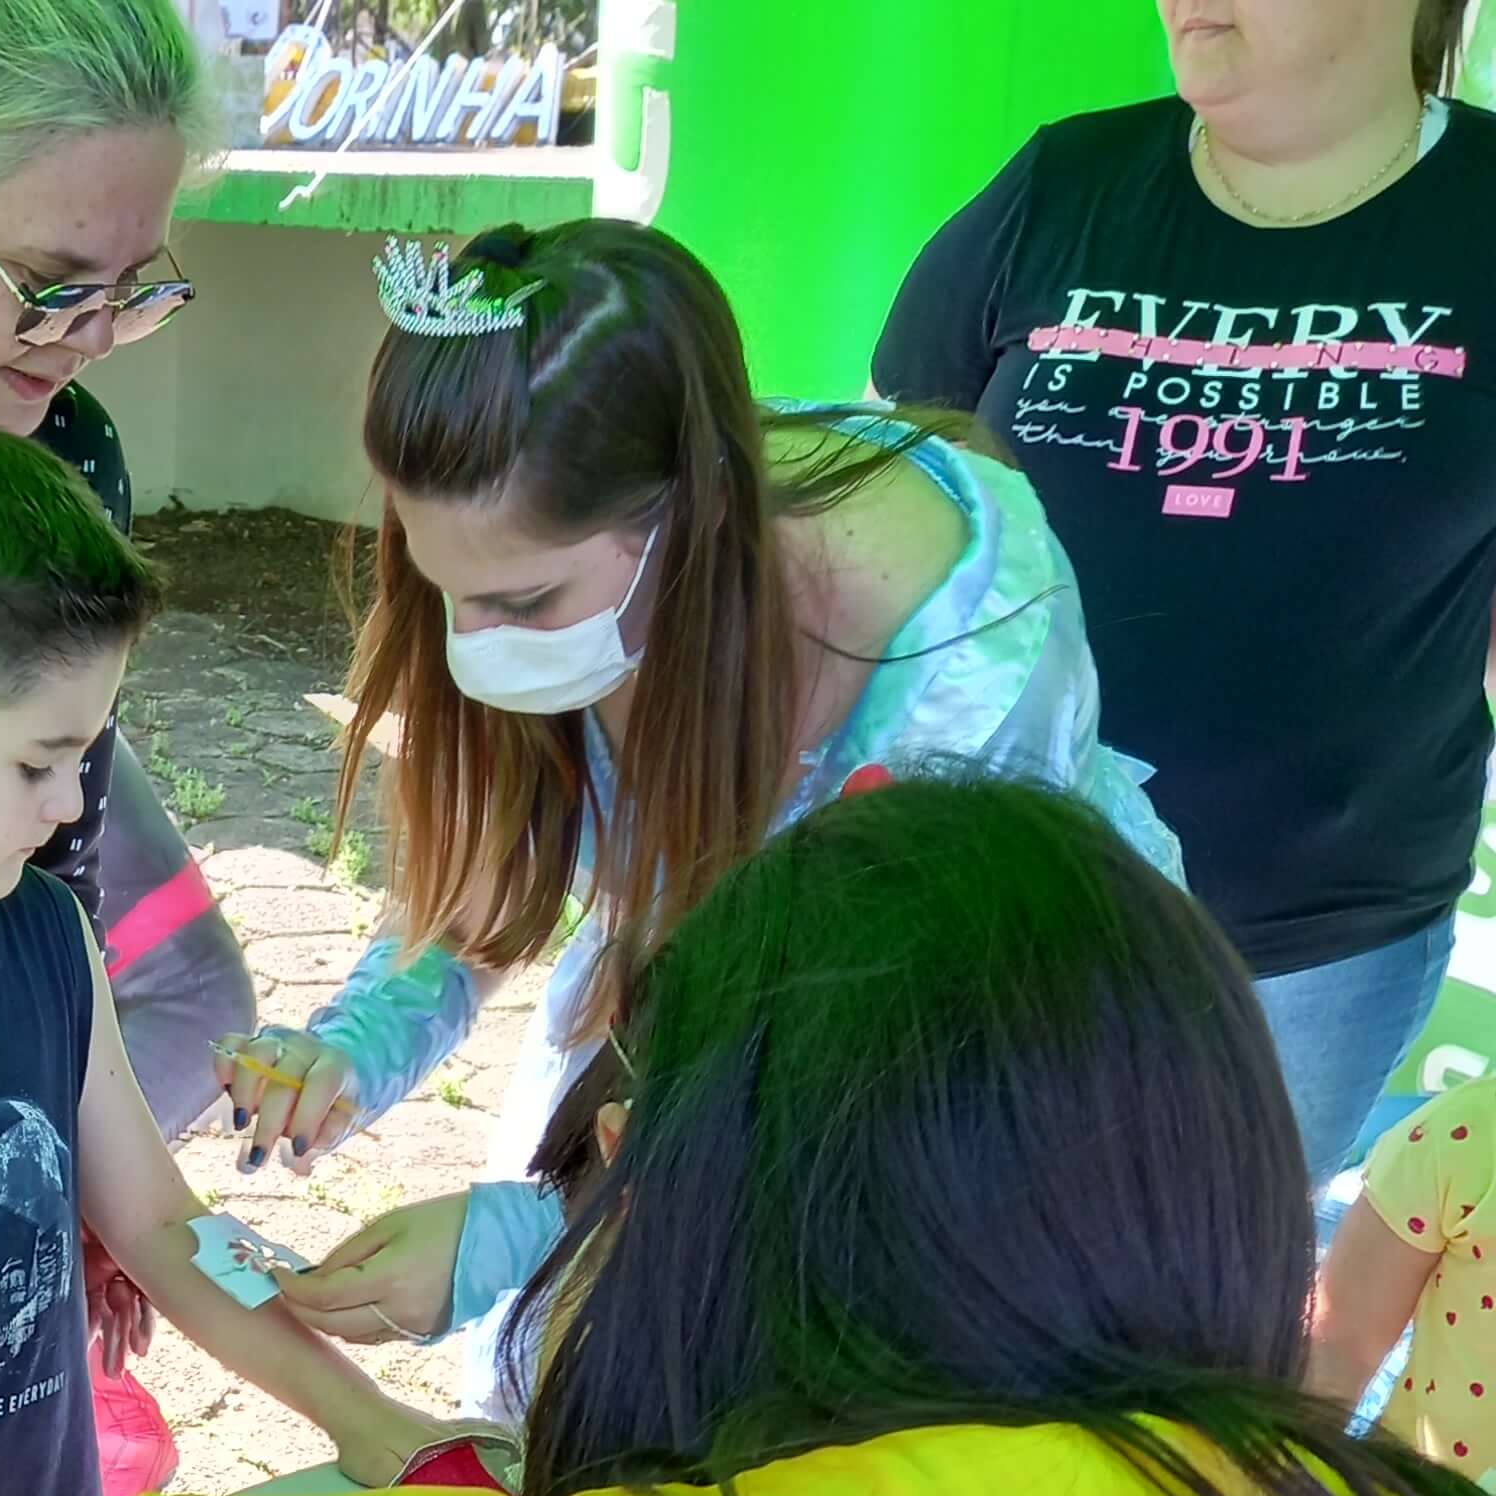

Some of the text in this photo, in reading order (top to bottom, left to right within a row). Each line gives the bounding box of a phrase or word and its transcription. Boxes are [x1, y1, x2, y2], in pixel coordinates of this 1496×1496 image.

[1039, 288, 1453, 380] EVERY
[1023, 362, 1422, 411] IS POSSIBLE
[1106, 406, 1307, 482] 1991
[1175, 493, 1224, 509] LOVE
